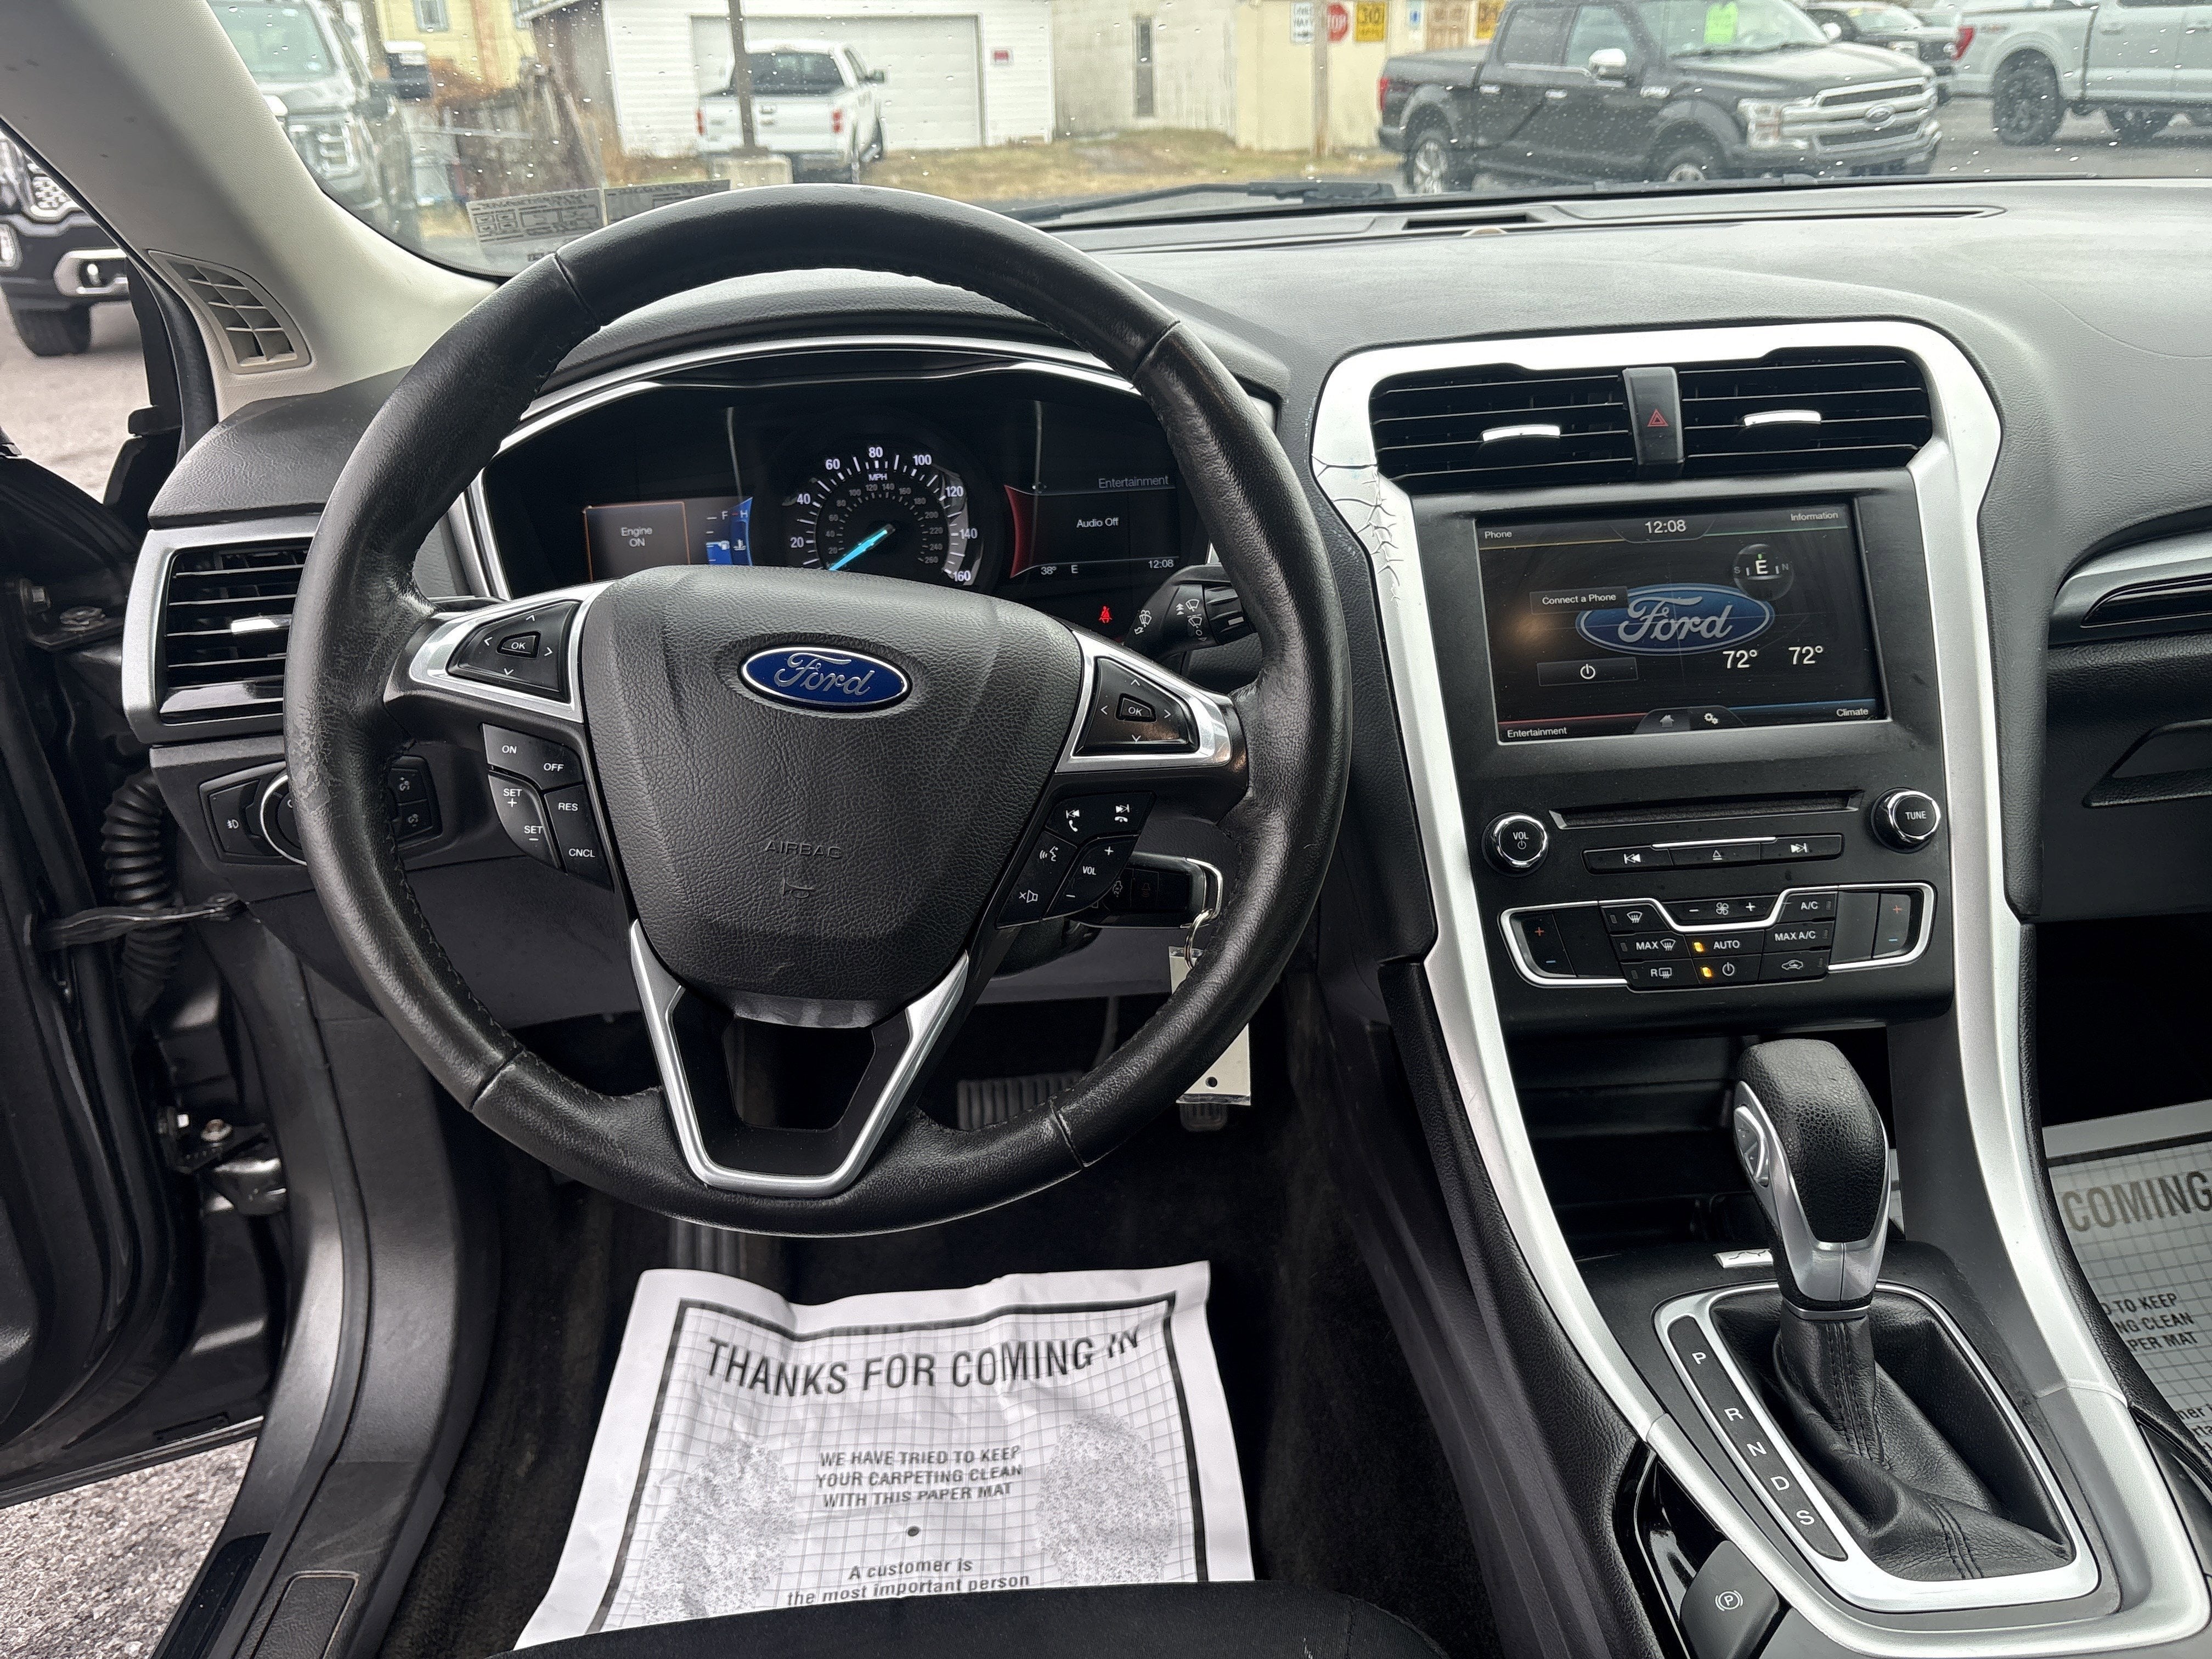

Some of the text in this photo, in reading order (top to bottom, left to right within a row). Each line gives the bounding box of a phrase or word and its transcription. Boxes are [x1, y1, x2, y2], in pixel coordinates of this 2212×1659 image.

[869, 447, 883, 458] 80
[826, 459, 840, 470] 60
[912, 454, 932, 465] 100
[1098, 475, 1169, 489] Entertainment
[945, 486, 963, 497] 120
[797, 494, 810, 505] 40
[721, 511, 728, 520] F
[740, 510, 748, 518] H
[1790, 511, 1839, 522] Information
[1076, 517, 1119, 528] Audio Off
[1644, 519, 1687, 534] 12:08
[620, 525, 653, 538] Engine
[960, 528, 978, 539] 140
[1485, 531, 1513, 539] Phone
[629, 538, 646, 548] ON
[790, 537, 804, 548] 20
[1071, 565, 1078, 574] E
[1149, 560, 1174, 569] 12:08
[1756, 560, 1768, 574] E
[953, 571, 971, 581] 160
[1542, 595, 1578, 605] Connect
[1589, 594, 1616, 602] Phone
[1618, 595, 1734, 642] Ford
[511, 641, 526, 650] OK
[1722, 650, 1757, 669] 72°
[1788, 645, 1823, 665] 72°
[774, 652, 875, 696] Ford
[1128, 706, 1143, 716] OK
[1836, 707, 1869, 718] Climate
[1506, 725, 1567, 738] Entertainment
[501, 746, 517, 754] ON
[543, 763, 564, 772] OFF
[503, 788, 522, 797] SET
[558, 803, 578, 811] RES
[1905, 810, 1926, 820] TUNE
[524, 826, 543, 834] SET
[1513, 831, 1529, 840] VOL
[568, 848, 595, 857] CNCL
[765, 840, 841, 859] AIRBAG
[1082, 866, 1096, 875] VOL
[1801, 901, 1818, 911] A/C
[1774, 930, 1816, 941] MAX A/C
[1635, 940, 1658, 951] MAX
[1713, 939, 1740, 950] AUTO
[1651, 967, 1658, 977] R
[2062, 1171, 2212, 1232] COMING
[2113, 1299, 2137, 1314] TO
[2138, 1293, 2177, 1311] KEEP
[2141, 1312, 2194, 1330] CLEAN
[2162, 1331, 2198, 1347] MAT
[708, 1329, 1139, 1397] THANKS FOR COMING IN
[1691, 1352, 1707, 1365] P
[1724, 1408, 1743, 1421] R
[1747, 1442, 1767, 1456] N
[821, 1445, 1022, 1466] WE HAVE TRIED TO KEEP
[816, 1465, 1023, 1488] YOUR CARPETING CLEAN
[1771, 1476, 1789, 1491] D
[823, 1482, 1012, 1508] WITH THIS PAPER MAT
[1797, 1509, 1815, 1526] S
[848, 1558, 973, 1581] A customer is
[788, 1574, 1030, 1607] the most important person
